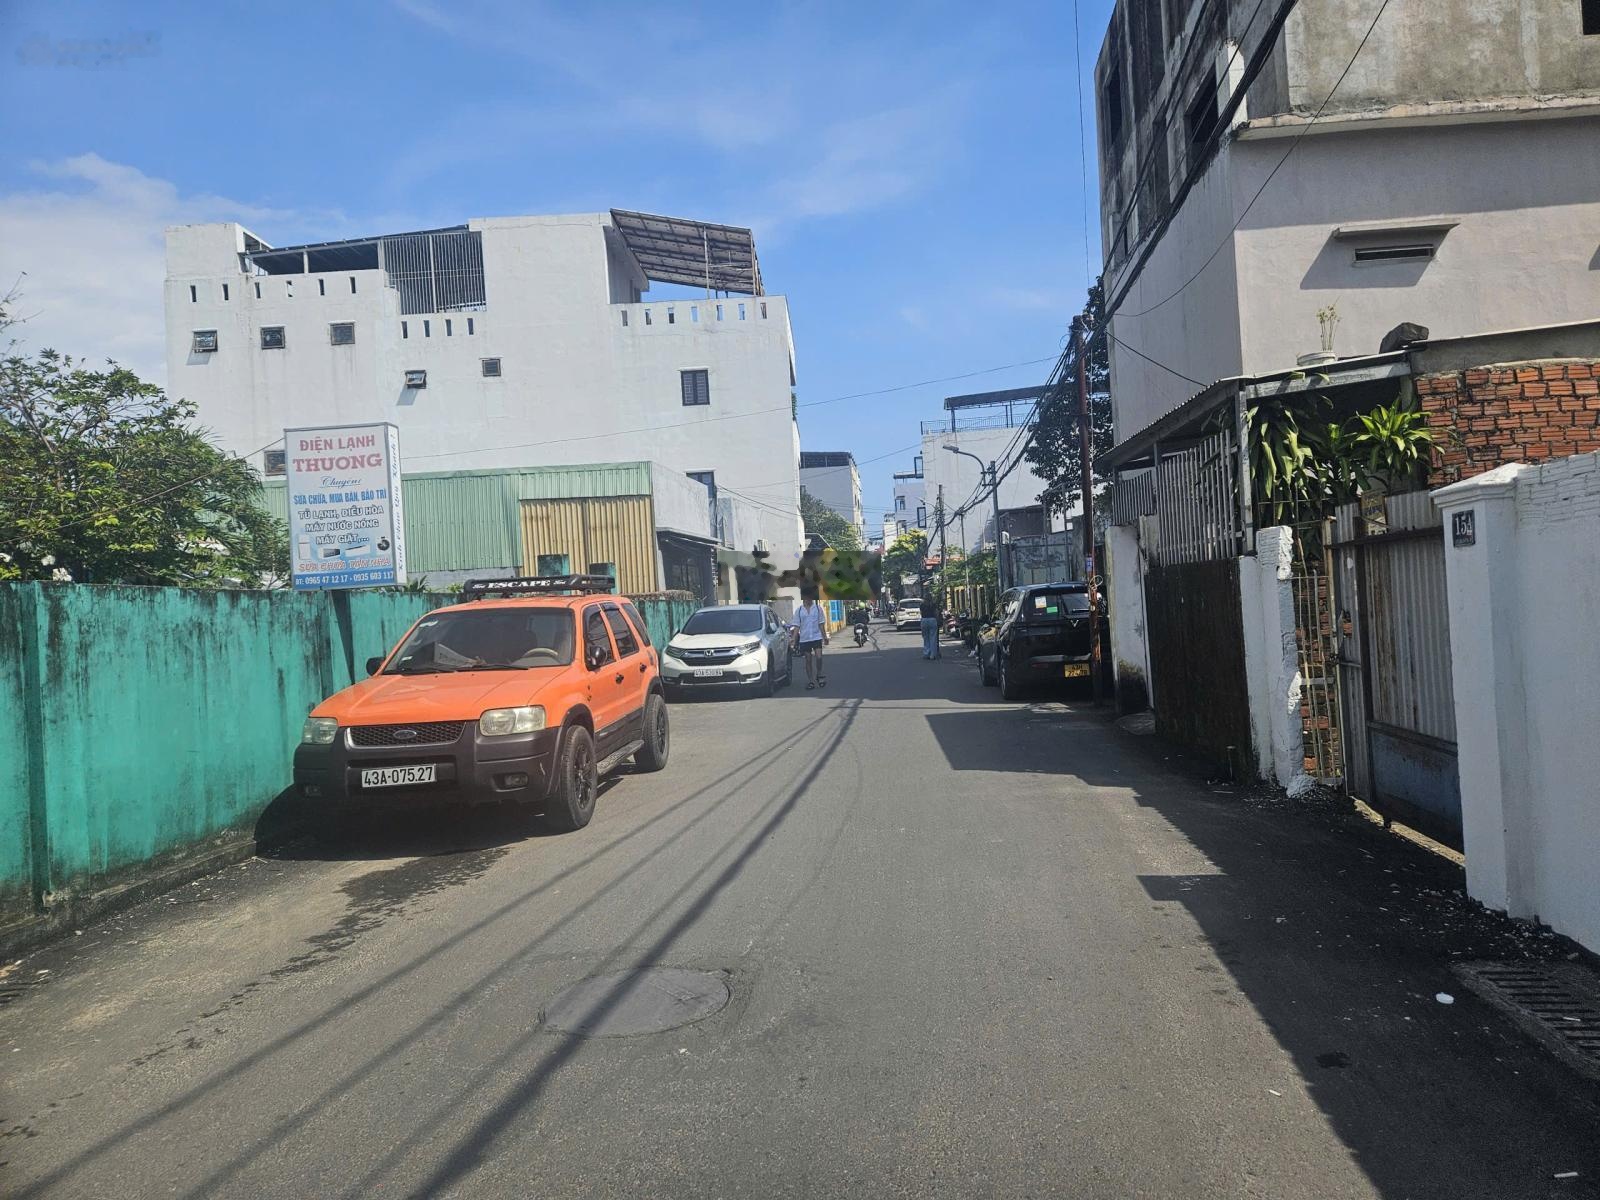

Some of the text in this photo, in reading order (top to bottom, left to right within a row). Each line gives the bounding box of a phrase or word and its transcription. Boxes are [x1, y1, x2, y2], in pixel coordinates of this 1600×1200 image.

[299, 434, 375, 454] ĐIỆN LẠNH
[330, 492, 344, 503] MUA
[364, 505, 384, 514] HÒA
[305, 518, 379, 532] MÁY NƯỚC NÓNG
[316, 534, 337, 545] MÁY
[322, 576, 330, 584] 47
[332, 575, 340, 583] 12
[340, 574, 348, 582] 17
[383, 571, 394, 580] 117
[487, 580, 550, 588] ESCAPE
[364, 766, 433, 786] 43A-075.27
